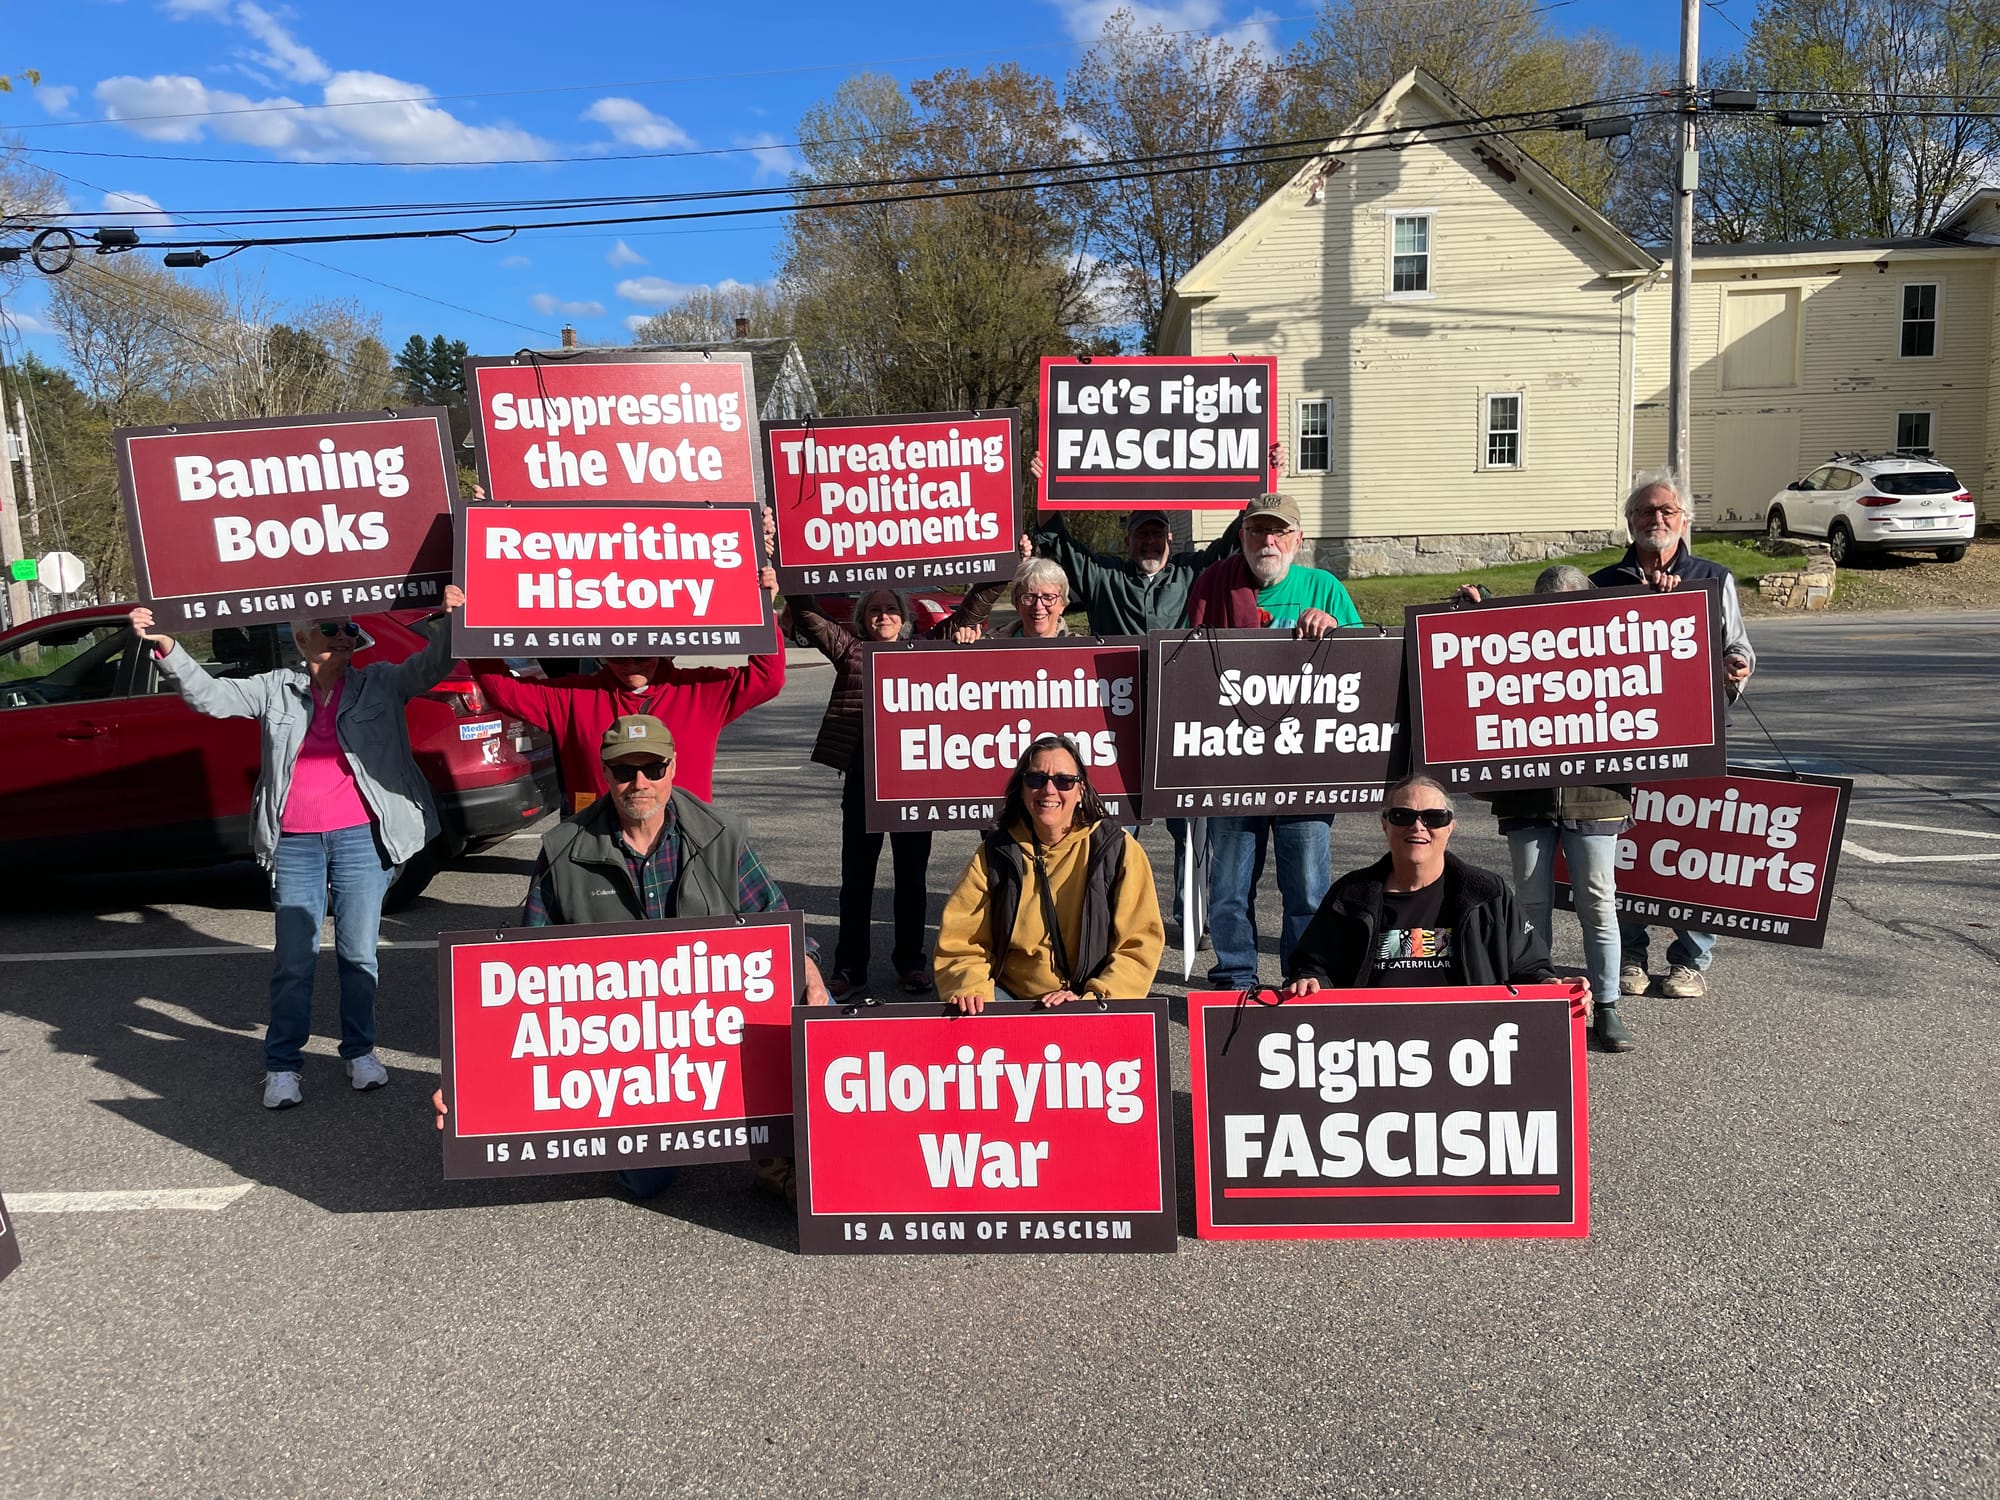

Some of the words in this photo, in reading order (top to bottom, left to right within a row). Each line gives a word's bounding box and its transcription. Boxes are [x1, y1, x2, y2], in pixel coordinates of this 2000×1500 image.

[492, 382, 741, 436] Suppressing
[1161, 375, 1261, 423] Fight
[175, 439, 409, 501] Banning
[524, 441, 607, 488] the
[617, 439, 722, 483] Vote
[781, 428, 1004, 474] Threatening
[1058, 429, 1259, 469] FASCISM
[820, 472, 971, 514] Political
[214, 504, 388, 562] Books
[486, 522, 742, 568] Rewriting
[805, 508, 998, 556] Opponents
[518, 568, 714, 616] History
[804, 571, 820, 584] IS
[828, 570, 839, 582] A
[847, 568, 887, 581] SIGN
[895, 566, 915, 578] OF
[924, 559, 995, 576] FASCISM
[184, 602, 206, 618] IS
[218, 600, 231, 615] A
[240, 591, 295, 614] SIGN
[305, 590, 331, 606] OF
[342, 579, 437, 604] FASCISM
[494, 633, 514, 646] IS
[525, 633, 538, 646] A
[549, 632, 602, 646] SIGN
[612, 633, 637, 645] OF
[648, 632, 740, 645] FASCISM
[1431, 610, 1697, 670] Prosecuting
[882, 668, 1133, 716] Undermining
[1219, 663, 1361, 712] Sowing
[1466, 654, 1663, 709] Personal
[461, 721, 501, 733] Medicare
[901, 719, 1118, 771] Electins
[1173, 719, 1265, 756] Hate
[1275, 717, 1303, 754] &
[1314, 719, 1400, 754] Fear
[1476, 700, 1658, 750] Enemies
[1452, 768, 1470, 782] IS
[1480, 767, 1492, 780] A
[1502, 763, 1550, 779] SIGN
[1560, 760, 1585, 775] OF
[1596, 754, 1688, 773] FASCISM
[902, 807, 918, 820] IS
[928, 806, 939, 819] A
[949, 805, 994, 819] SIGN
[1177, 794, 1193, 807] IS
[1202, 794, 1213, 806] A
[1222, 792, 1266, 806] SIGN
[1275, 792, 1297, 804] OF
[1305, 789, 1384, 803] FASCISM
[1631, 787, 1801, 850] noring
[1649, 839, 1816, 896] Courts
[1615, 898, 1660, 916] SIGN
[1669, 907, 1693, 920] OF
[1702, 912, 1789, 934] FASCISM
[481, 941, 774, 1008] Demanding
[1374, 962, 1386, 970] HE
[1388, 960, 1451, 969] CATERPILLAR
[511, 1000, 744, 1060] Absolute
[533, 1053, 726, 1117] Loyalty
[824, 1044, 1144, 1125] Glorifying
[1259, 1024, 1432, 1102] Signs
[1449, 1023, 1518, 1086] of
[487, 1143, 509, 1162] IS
[521, 1142, 536, 1160] A
[547, 1138, 605, 1158] SIGN
[618, 1135, 648, 1154] OF
[660, 1126, 770, 1152] FASCISM
[919, 1133, 1049, 1188] War
[1225, 1111, 1557, 1177] FASCISM
[844, 1222, 867, 1241] IS
[879, 1222, 894, 1240] A
[905, 1221, 966, 1240] SIGN
[977, 1221, 1008, 1239] OF
[1020, 1220, 1132, 1239] FASCISM
